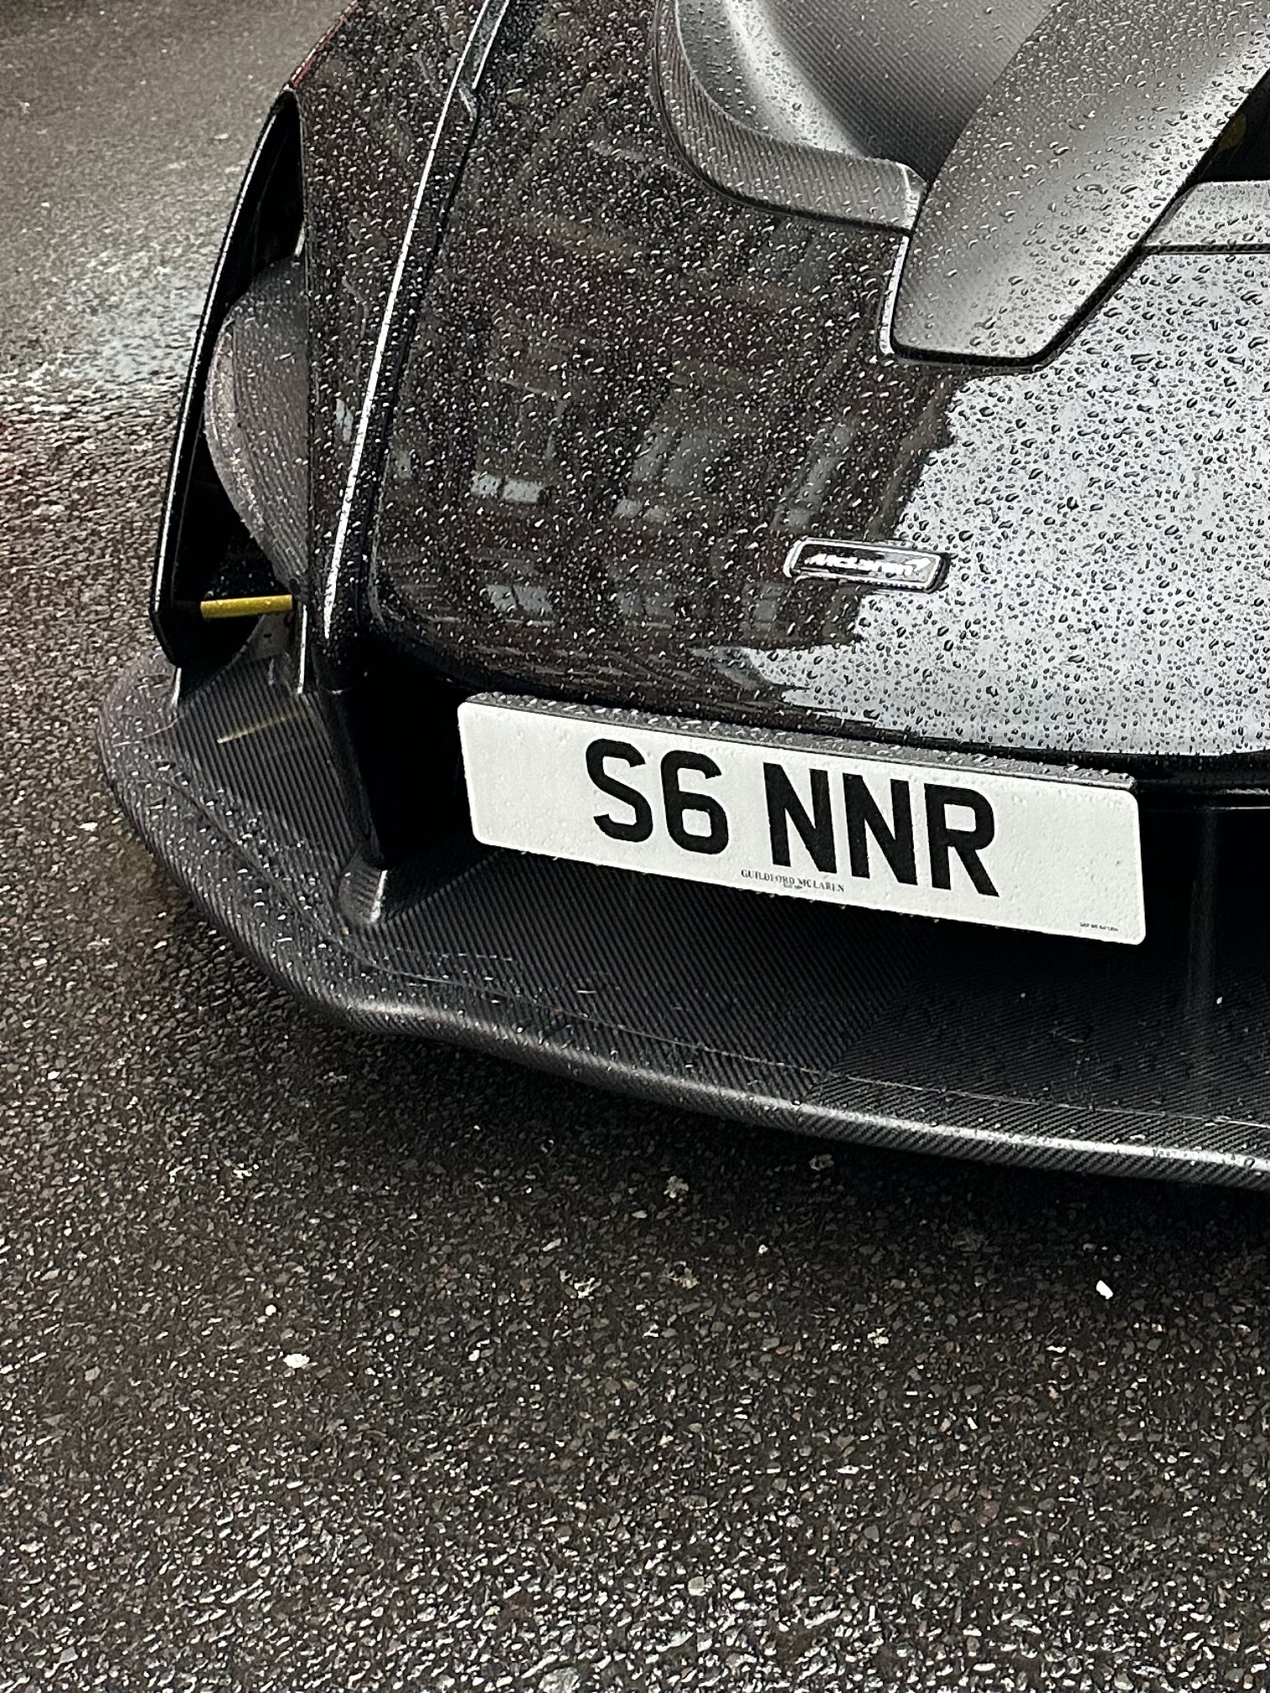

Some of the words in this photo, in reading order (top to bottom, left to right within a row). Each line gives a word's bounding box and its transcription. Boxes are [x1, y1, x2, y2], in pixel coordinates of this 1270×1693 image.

[584, 737, 729, 855] S6
[762, 761, 1000, 898] NNR
[740, 868, 796, 886] GUILDFORD
